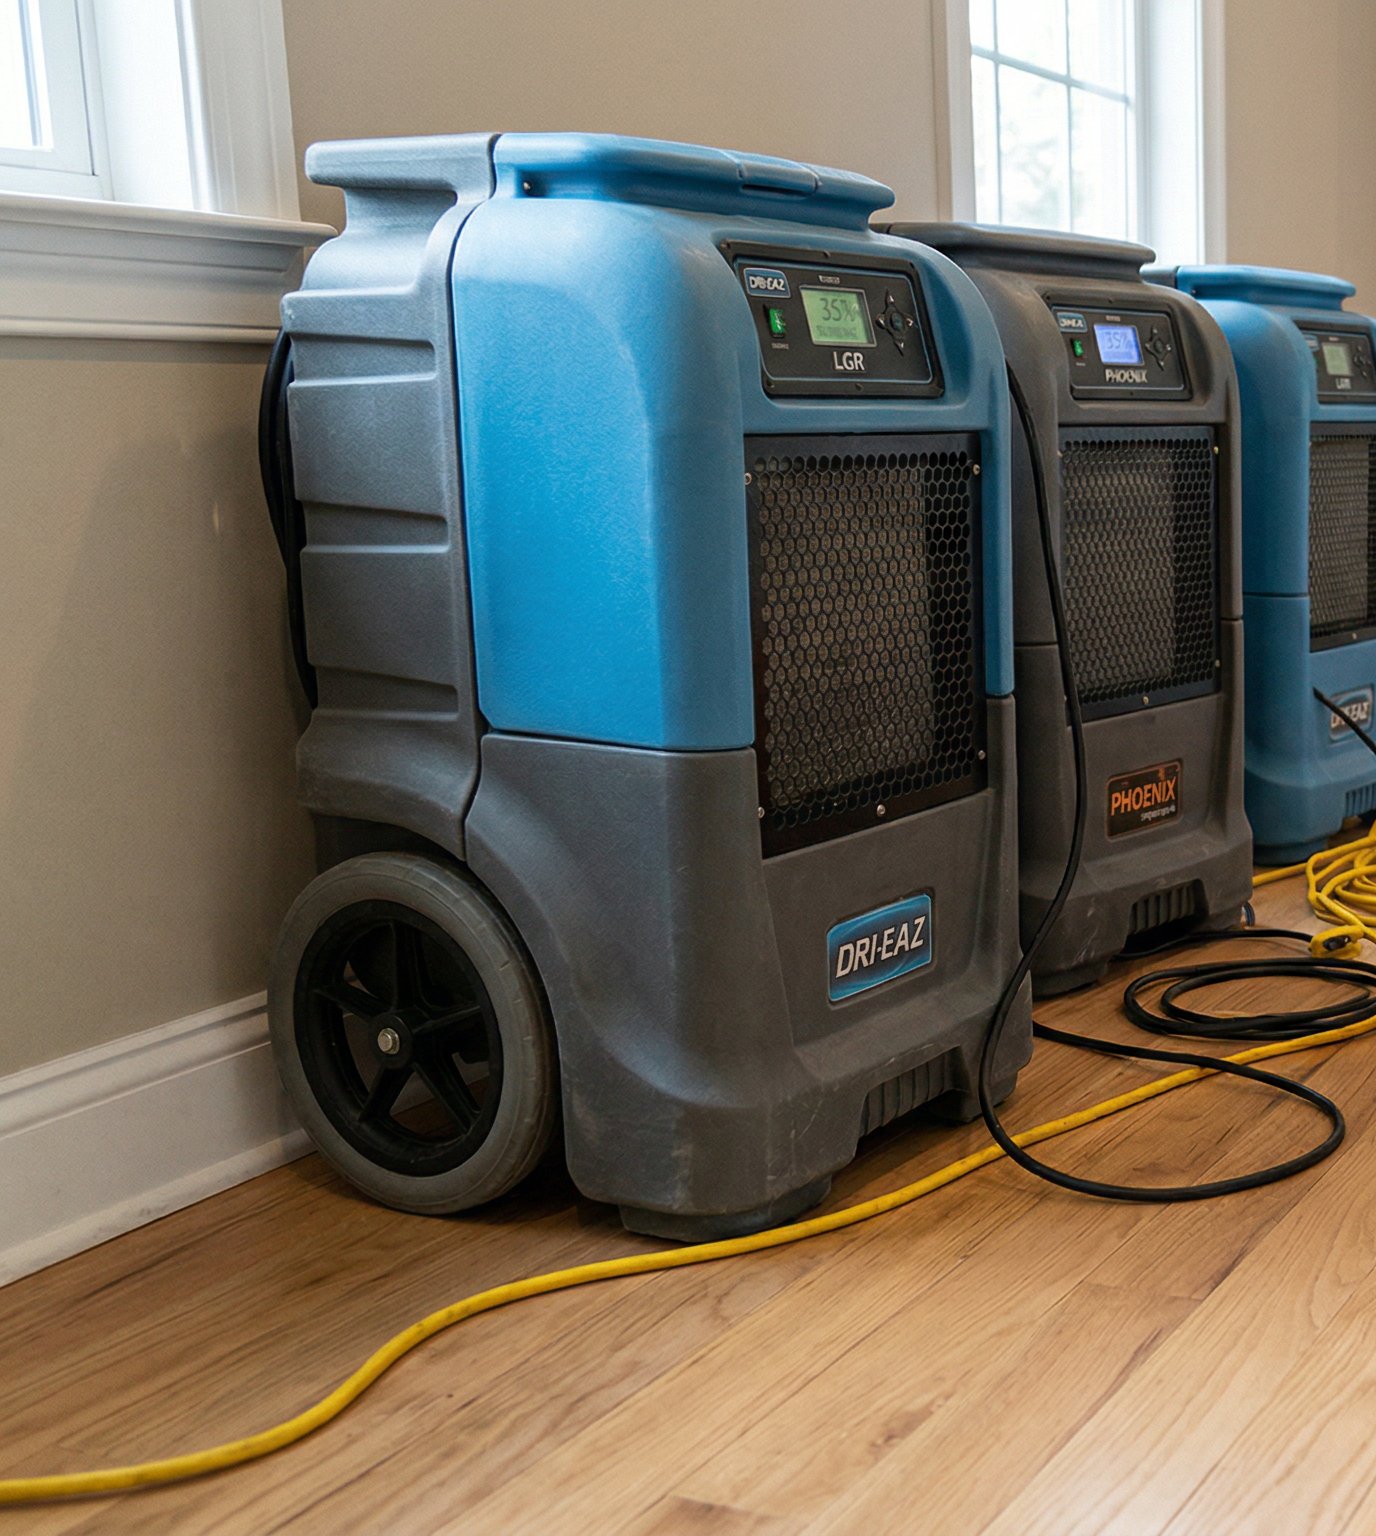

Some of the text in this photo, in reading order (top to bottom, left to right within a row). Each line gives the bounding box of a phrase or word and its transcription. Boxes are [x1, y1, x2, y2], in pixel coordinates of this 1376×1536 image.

[833, 351, 866, 371] LGR
[1110, 776, 1177, 817] PHOENIX
[835, 915, 926, 979] DRI-EAZ
